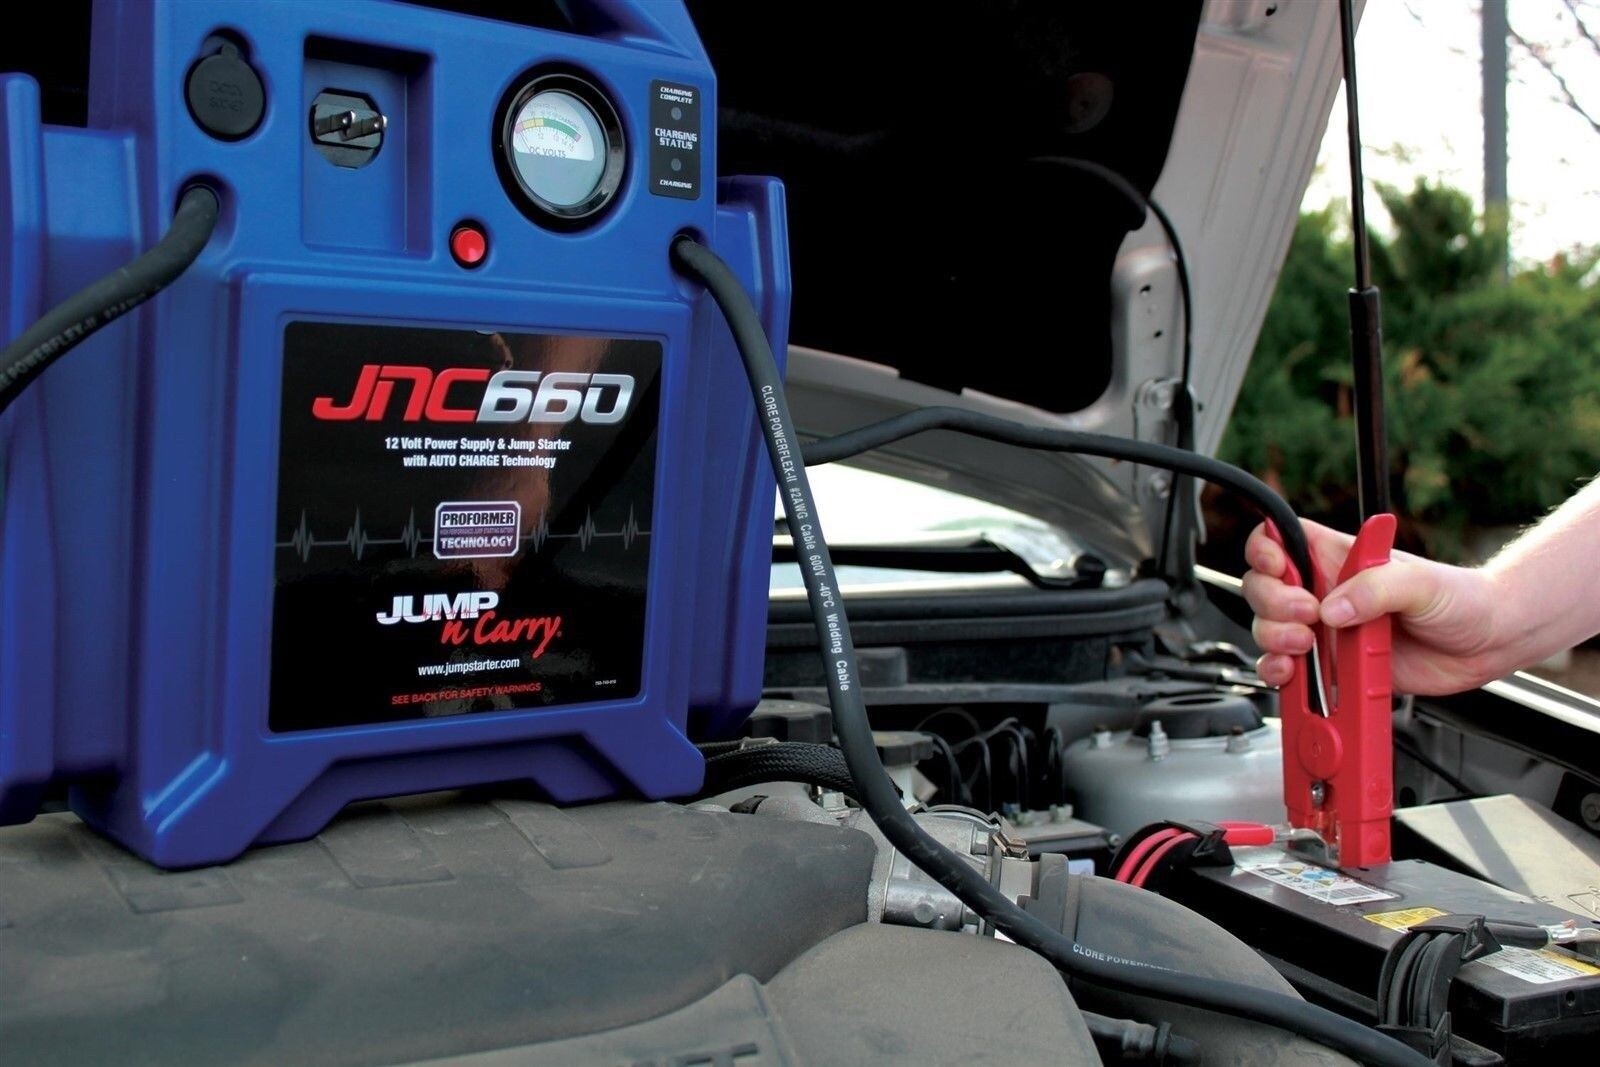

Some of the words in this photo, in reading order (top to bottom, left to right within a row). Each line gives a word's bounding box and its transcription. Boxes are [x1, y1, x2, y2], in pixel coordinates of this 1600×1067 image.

[660, 86, 693, 97] CHARGING
[660, 93, 693, 104] COMPLETE
[655, 127, 697, 142] CHARGING
[660, 137, 693, 150] STATUS
[543, 148, 567, 158] VOLTS
[660, 179, 692, 189] CHARGING
[312, 364, 636, 424] JNC660
[385, 437, 399, 449] 12
[401, 437, 422, 449] Volt
[424, 438, 457, 450] Power
[460, 438, 495, 452] Supply
[497, 438, 508, 450] &
[508, 438, 535, 452] Jump
[537, 439, 571, 450] Starter
[403, 455, 427, 467] with
[429, 455, 456, 466] AUTO
[459, 455, 500, 467] CHARGE
[502, 455, 557, 468] Technology
[442, 511, 514, 526] PROFORMER
[440, 535, 514, 549] TECHNOLOGY
[761, 385, 779, 416] CLORE
[800, 524, 816, 550] Cable
[809, 554, 826, 576] 600V
[826, 613, 843, 654] Welding
[836, 660, 849, 691] Cable
[376, 591, 499, 625] JUMP
[441, 620, 469, 645] n
[418, 658, 520, 676] www.jumpstarter.com
[392, 695, 409, 705] SEE
[412, 693, 437, 703] BACK
[440, 690, 459, 701] FOR
[460, 687, 494, 699] SAFETY
[495, 682, 542, 695] WARNINGS
[1073, 943, 1105, 961] CLORE
